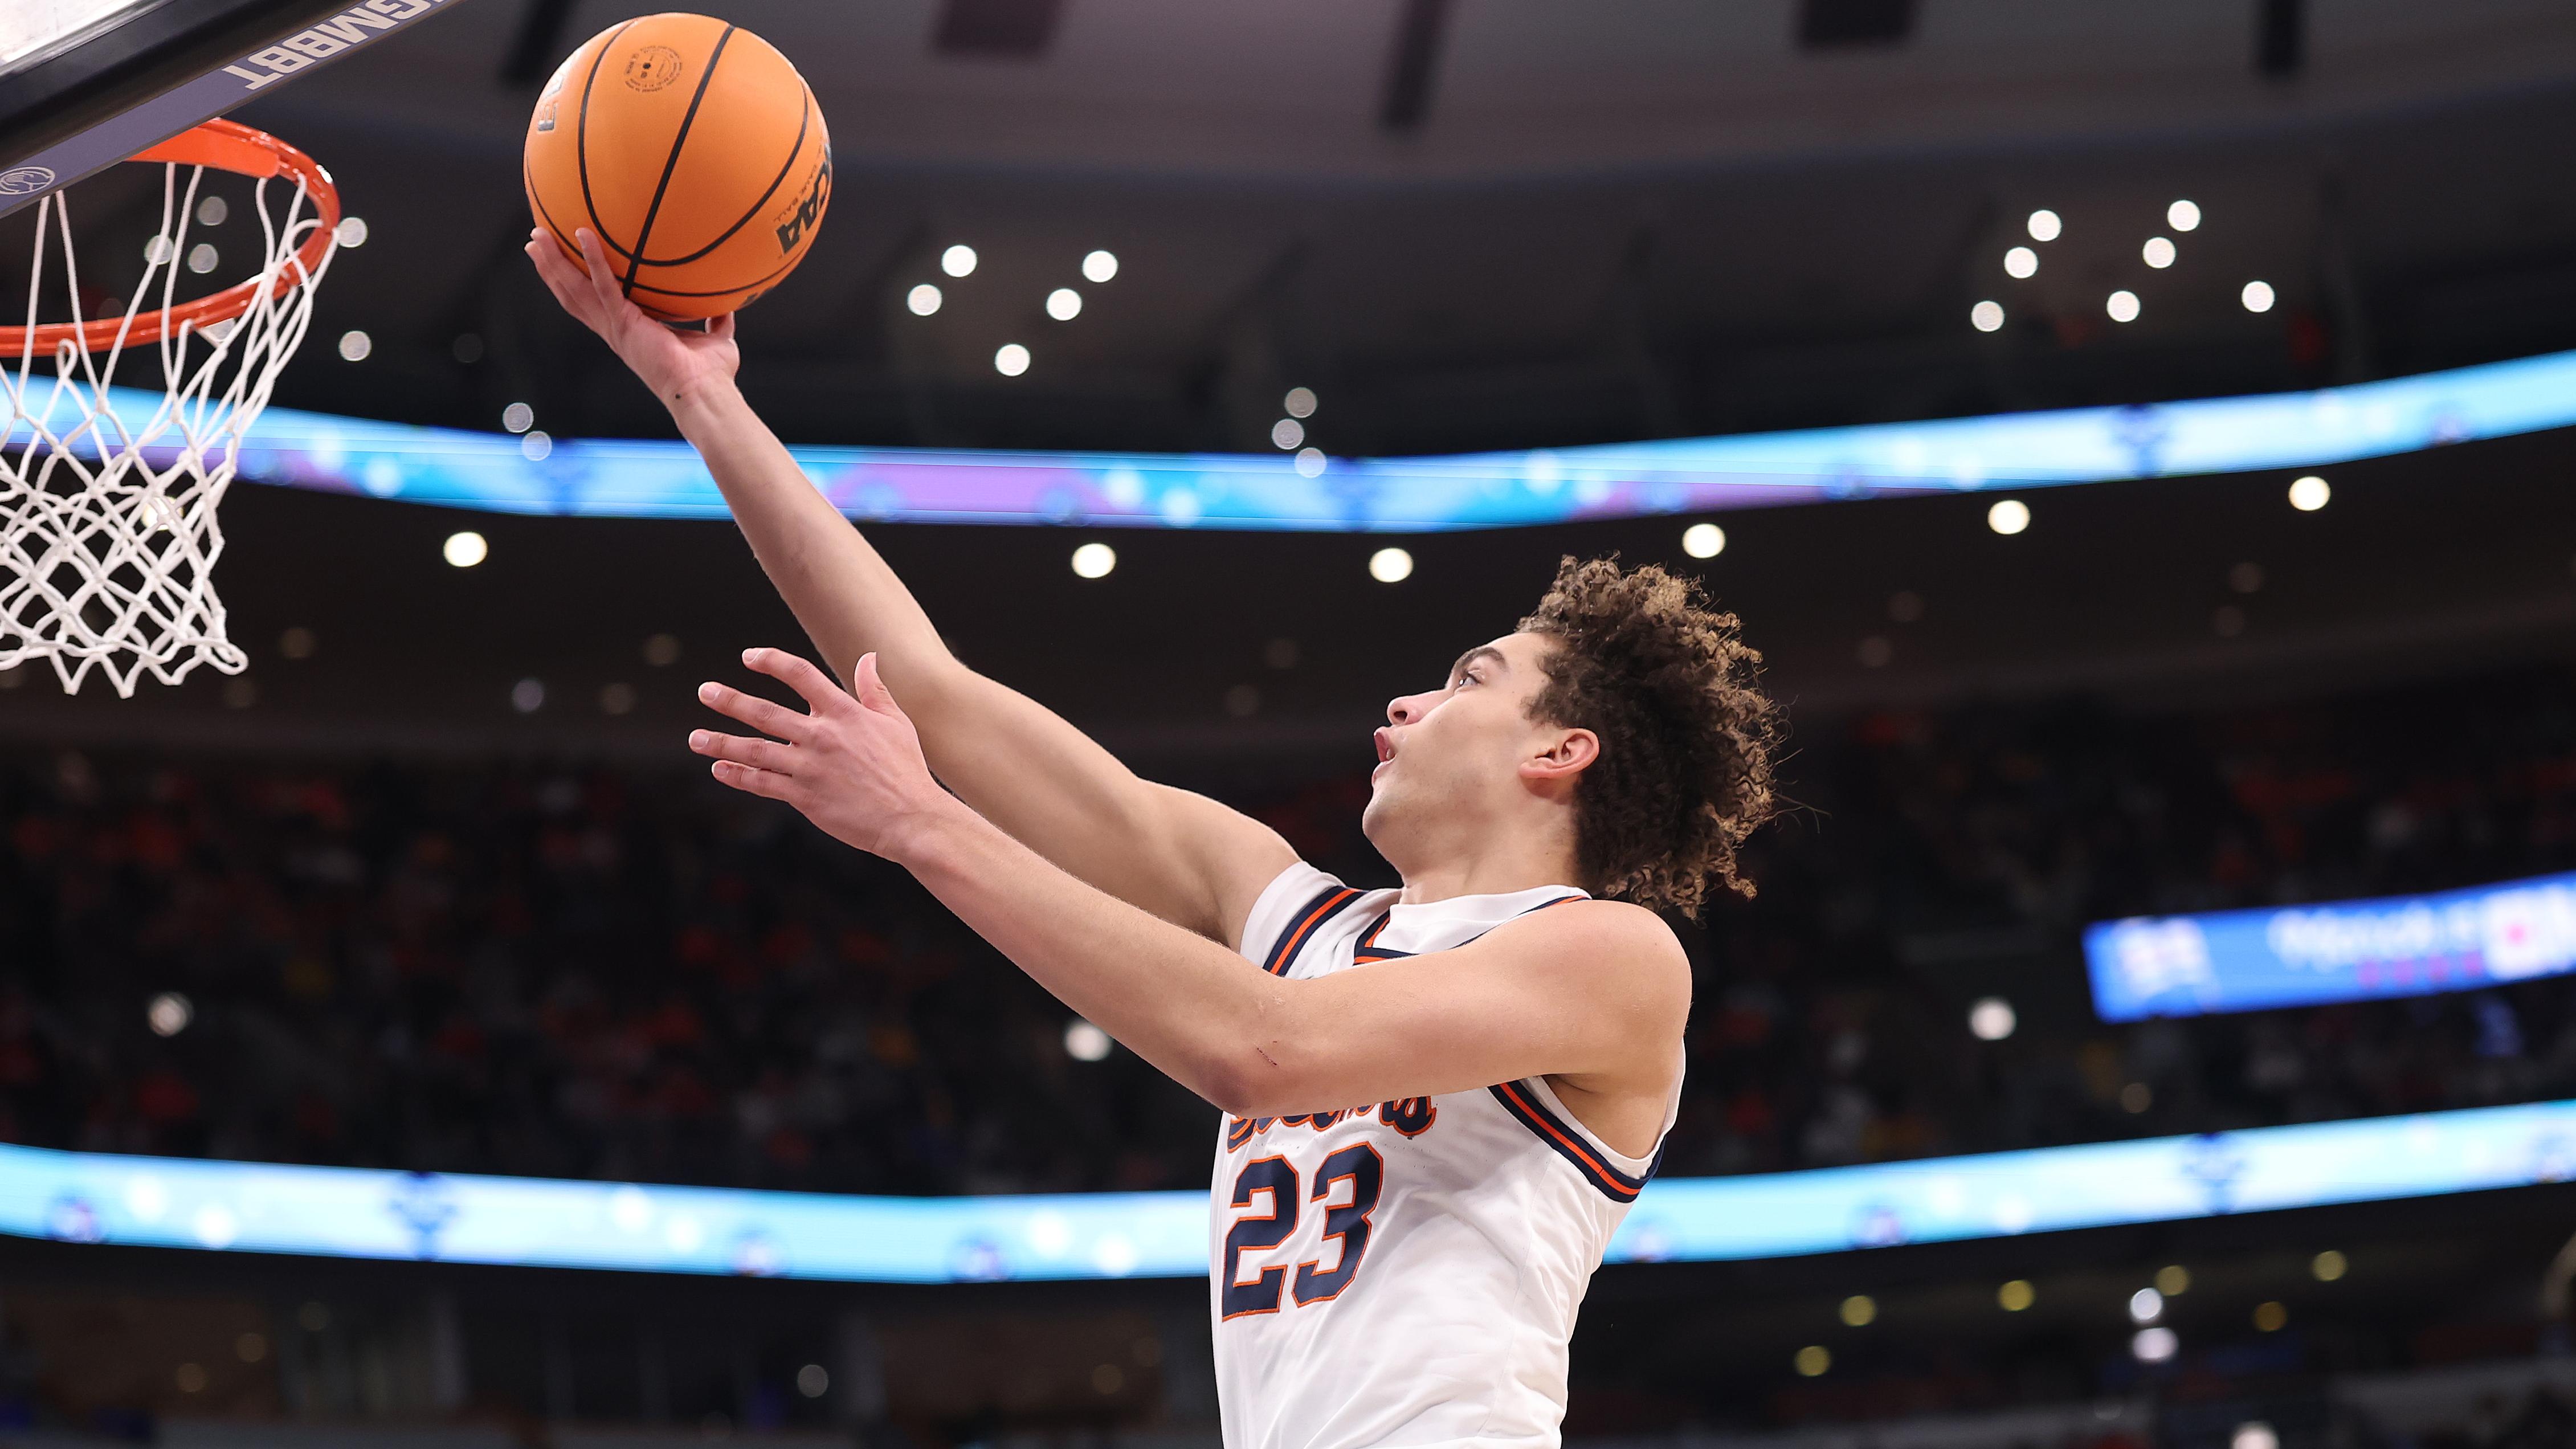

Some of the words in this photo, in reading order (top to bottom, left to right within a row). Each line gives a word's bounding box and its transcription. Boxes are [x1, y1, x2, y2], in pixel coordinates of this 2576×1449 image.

[222, 0, 443, 90] GMBBT
[775, 144, 832, 255] CAA
[1222, 1141, 1384, 1322] 23
